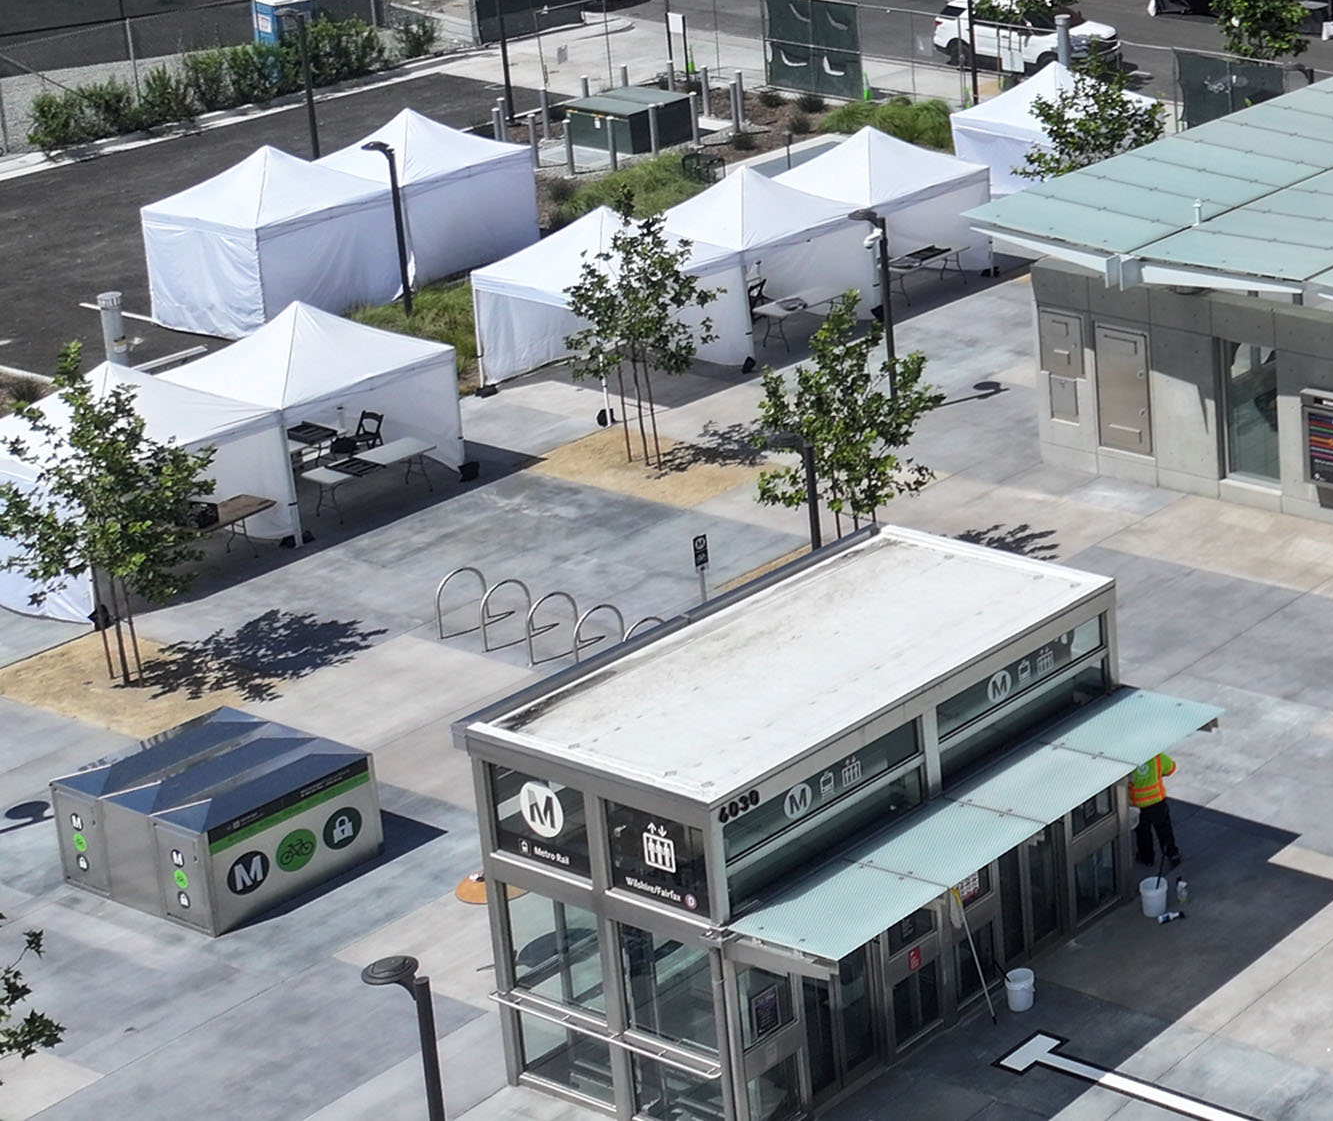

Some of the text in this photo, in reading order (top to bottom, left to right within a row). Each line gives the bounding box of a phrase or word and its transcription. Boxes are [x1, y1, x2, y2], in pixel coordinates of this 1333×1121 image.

[526, 788, 556, 830] M
[718, 789, 760, 824] 6030
[233, 854, 264, 892] M
[533, 845, 570, 866] Metro Rail
